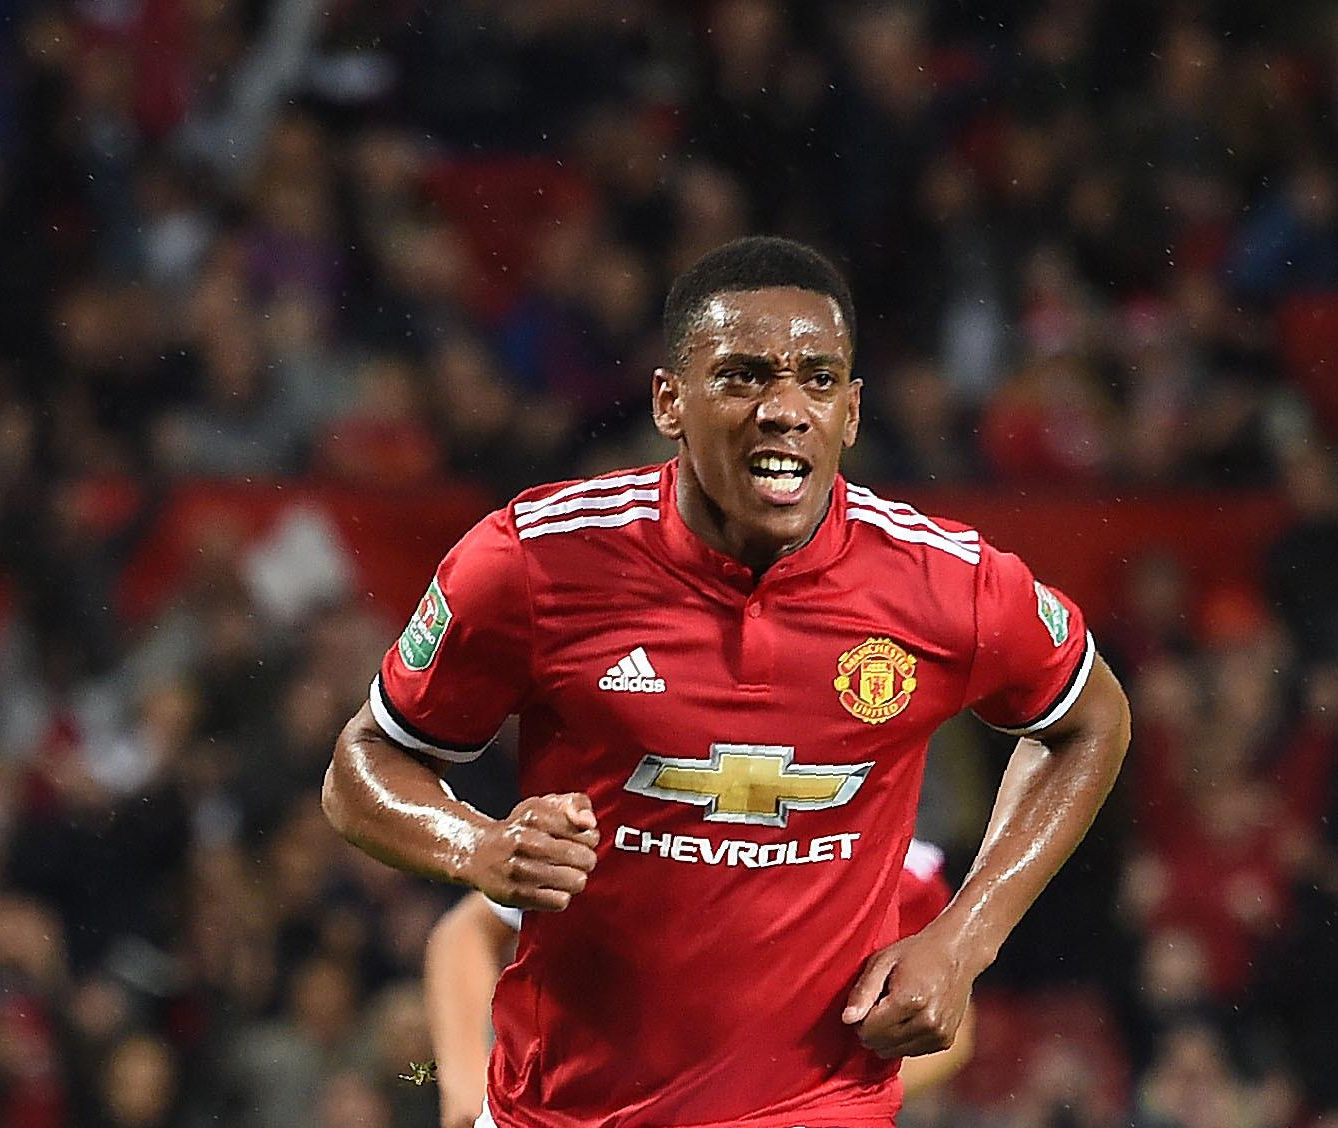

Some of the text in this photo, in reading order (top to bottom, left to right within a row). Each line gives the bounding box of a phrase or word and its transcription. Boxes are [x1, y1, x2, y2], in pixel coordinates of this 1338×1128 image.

[843, 643, 910, 673] MANCHESTER
[599, 674, 666, 693] adidas
[852, 702, 899, 718] UNITED
[614, 825, 861, 868] CHEVROLET
